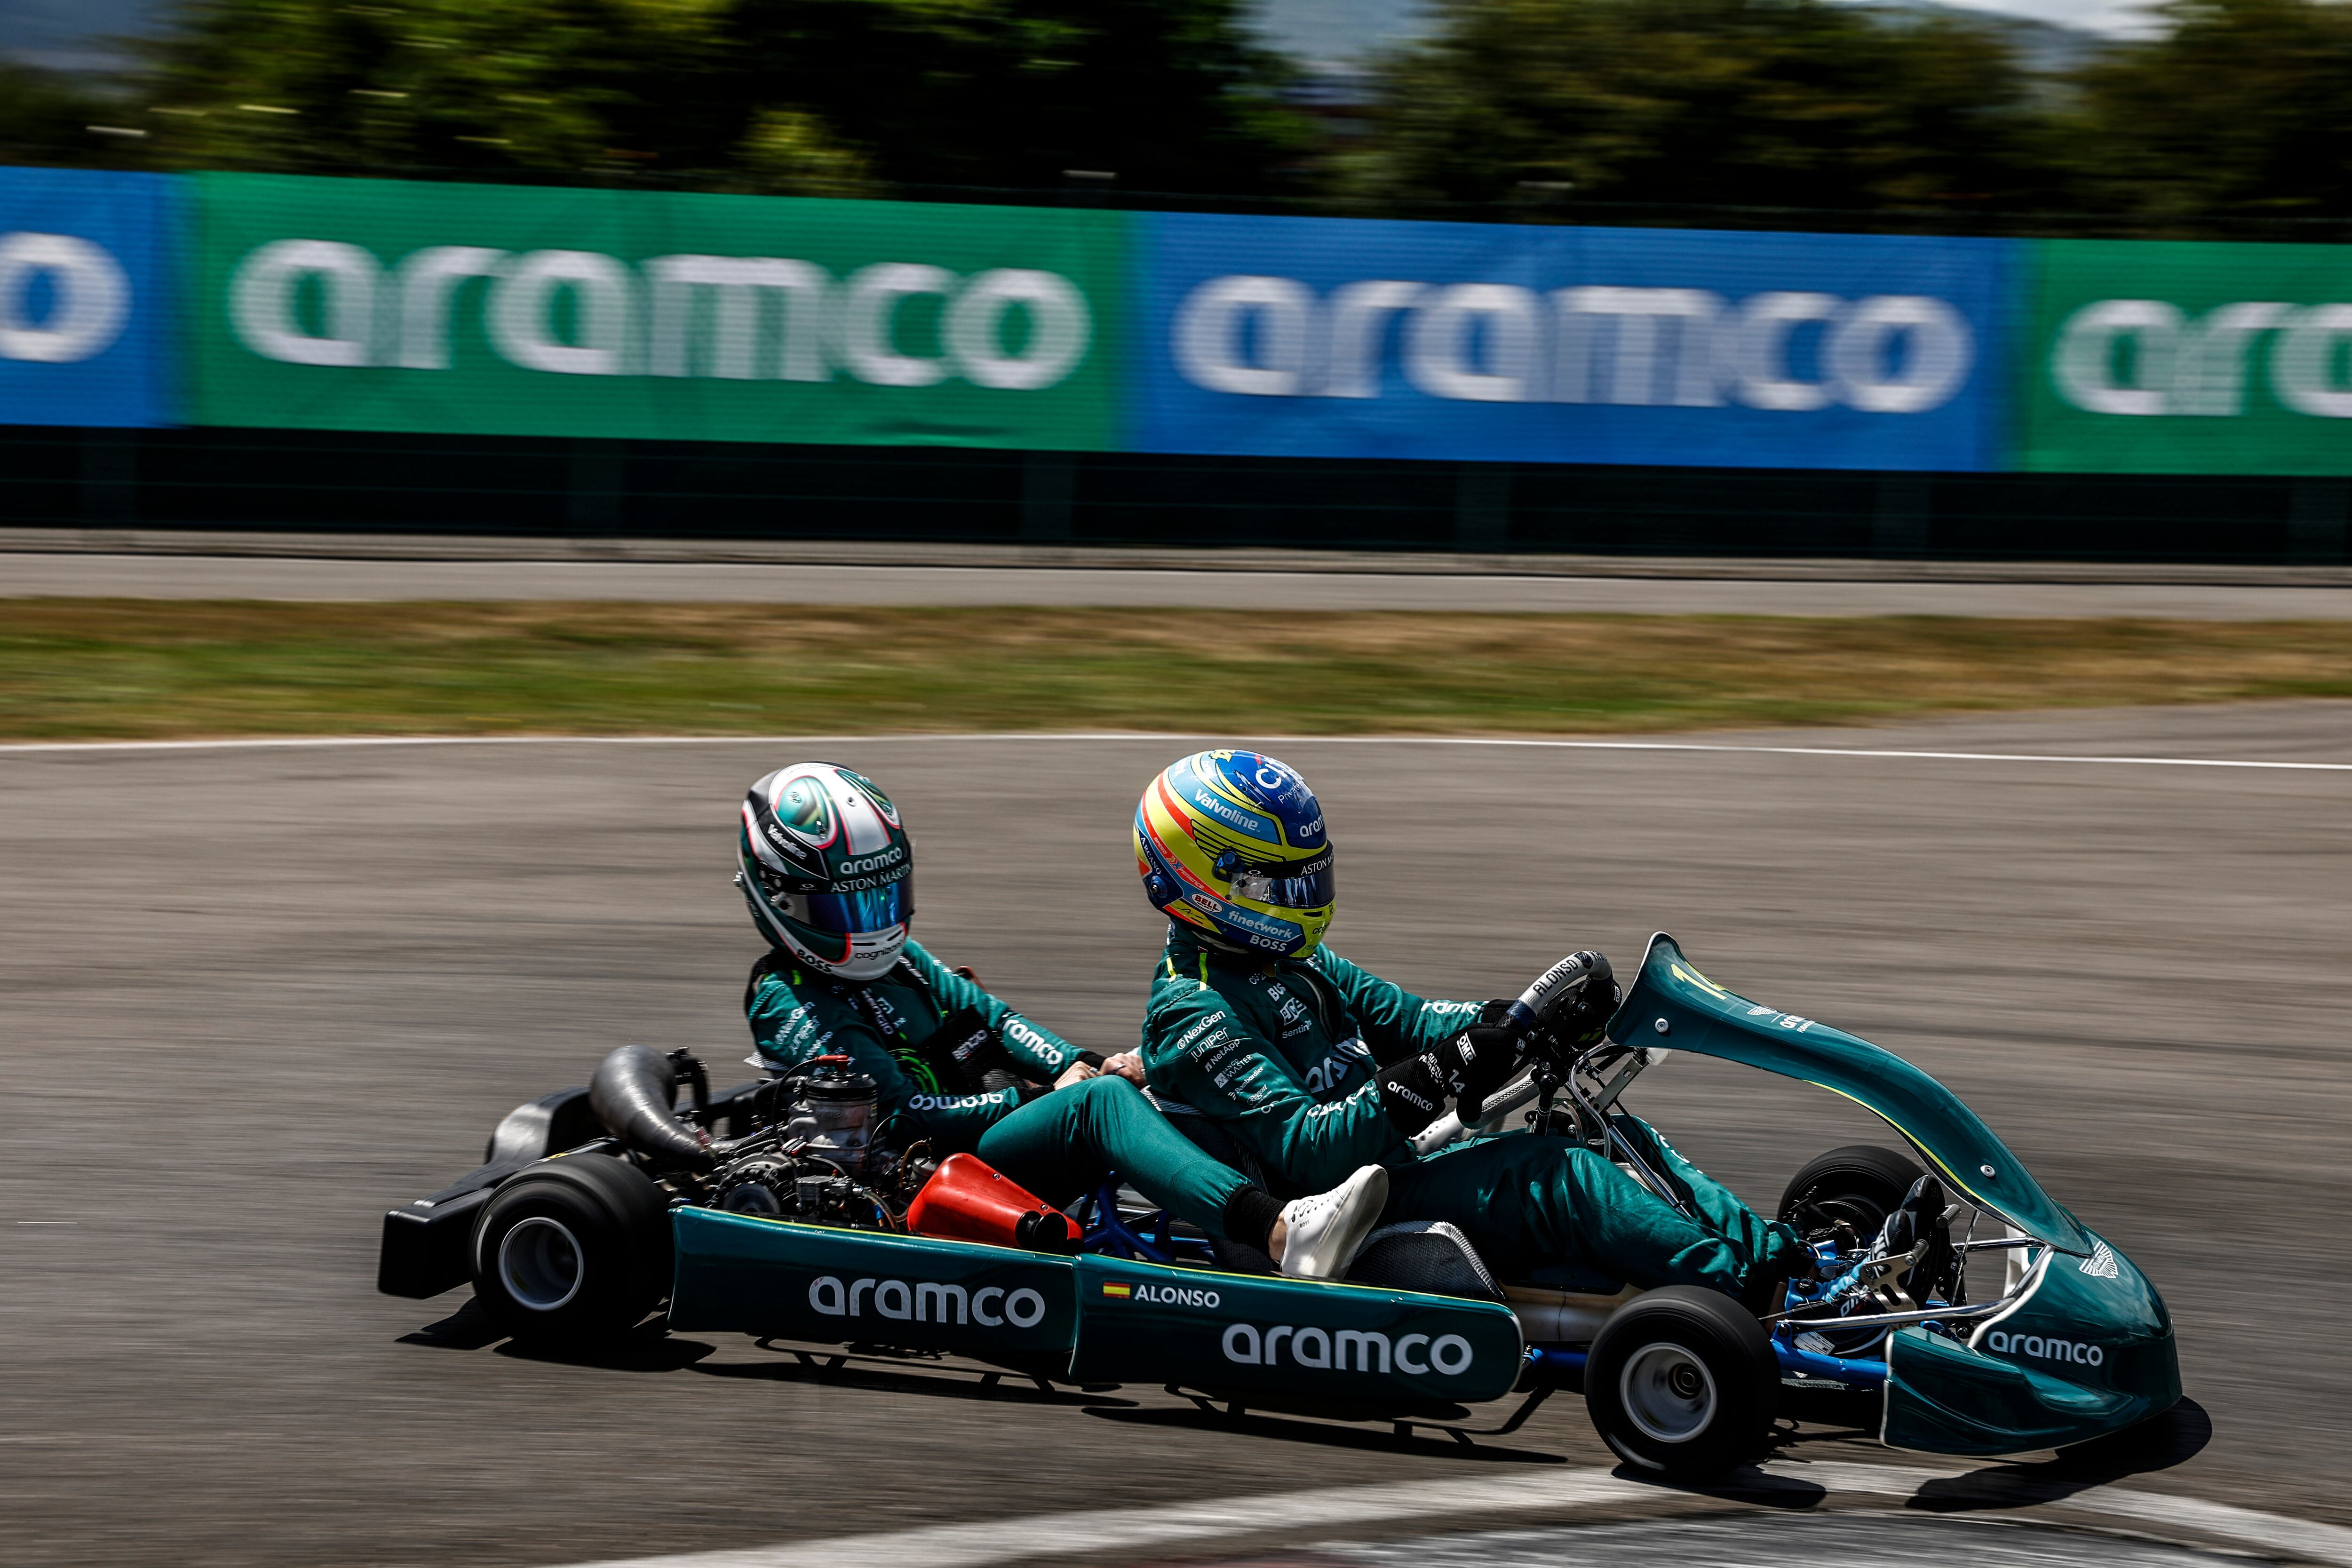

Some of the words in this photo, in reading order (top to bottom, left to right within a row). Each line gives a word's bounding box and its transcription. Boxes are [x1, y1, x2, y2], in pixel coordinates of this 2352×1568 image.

[228, 239, 1095, 390] aramco
[1170, 275, 1974, 414] aramco
[840, 847, 903, 874] aramco
[1301, 858, 1327, 876] ASTON
[831, 876, 877, 892] ASTON
[1228, 910, 1293, 939] finetwork
[1249, 935, 1287, 952] BOSS
[797, 949, 833, 973] BOSS
[1533, 959, 1579, 997] ALONSO
[1002, 1015, 1063, 1065] ramco
[1183, 1011, 1226, 1043] NexGen
[1210, 1039, 1240, 1065] NetApp
[1459, 1035, 1473, 1060] OMP
[1235, 1067, 1264, 1093] Bombardier
[1388, 1081, 1433, 1111] aramco
[809, 1275, 1045, 1328] aramco
[1134, 1284, 1220, 1308] ALONSO
[1223, 1323, 1473, 1375] aramco
[1988, 1331, 2103, 1366] aramco
